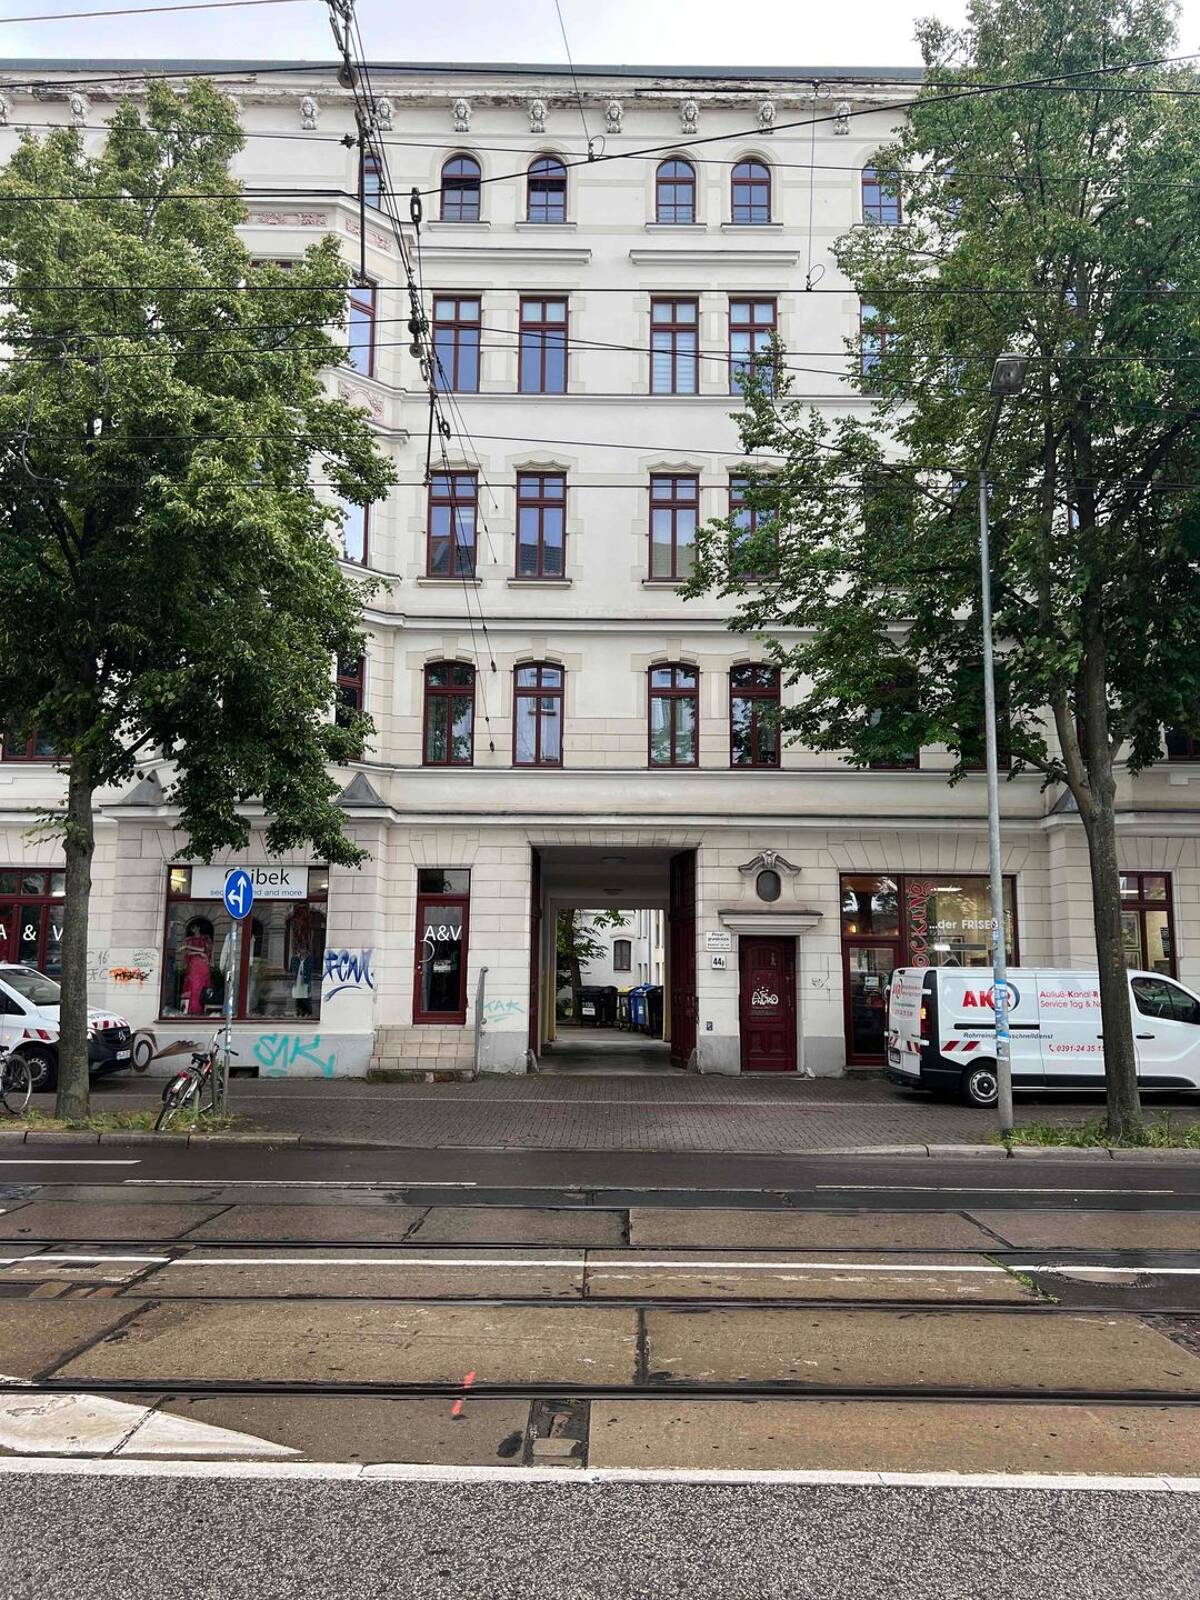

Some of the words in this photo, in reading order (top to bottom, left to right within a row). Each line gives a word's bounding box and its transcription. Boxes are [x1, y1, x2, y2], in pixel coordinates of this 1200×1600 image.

[225, 868, 290, 885] ibek
[264, 888, 280, 897] and
[0, 923, 8, 940] A
[22, 923, 37, 941] &
[52, 924, 64, 941] V
[961, 919, 997, 931] FRISE
[423, 924, 463, 941] A&V
[1040, 1000, 1068, 1009] Service
